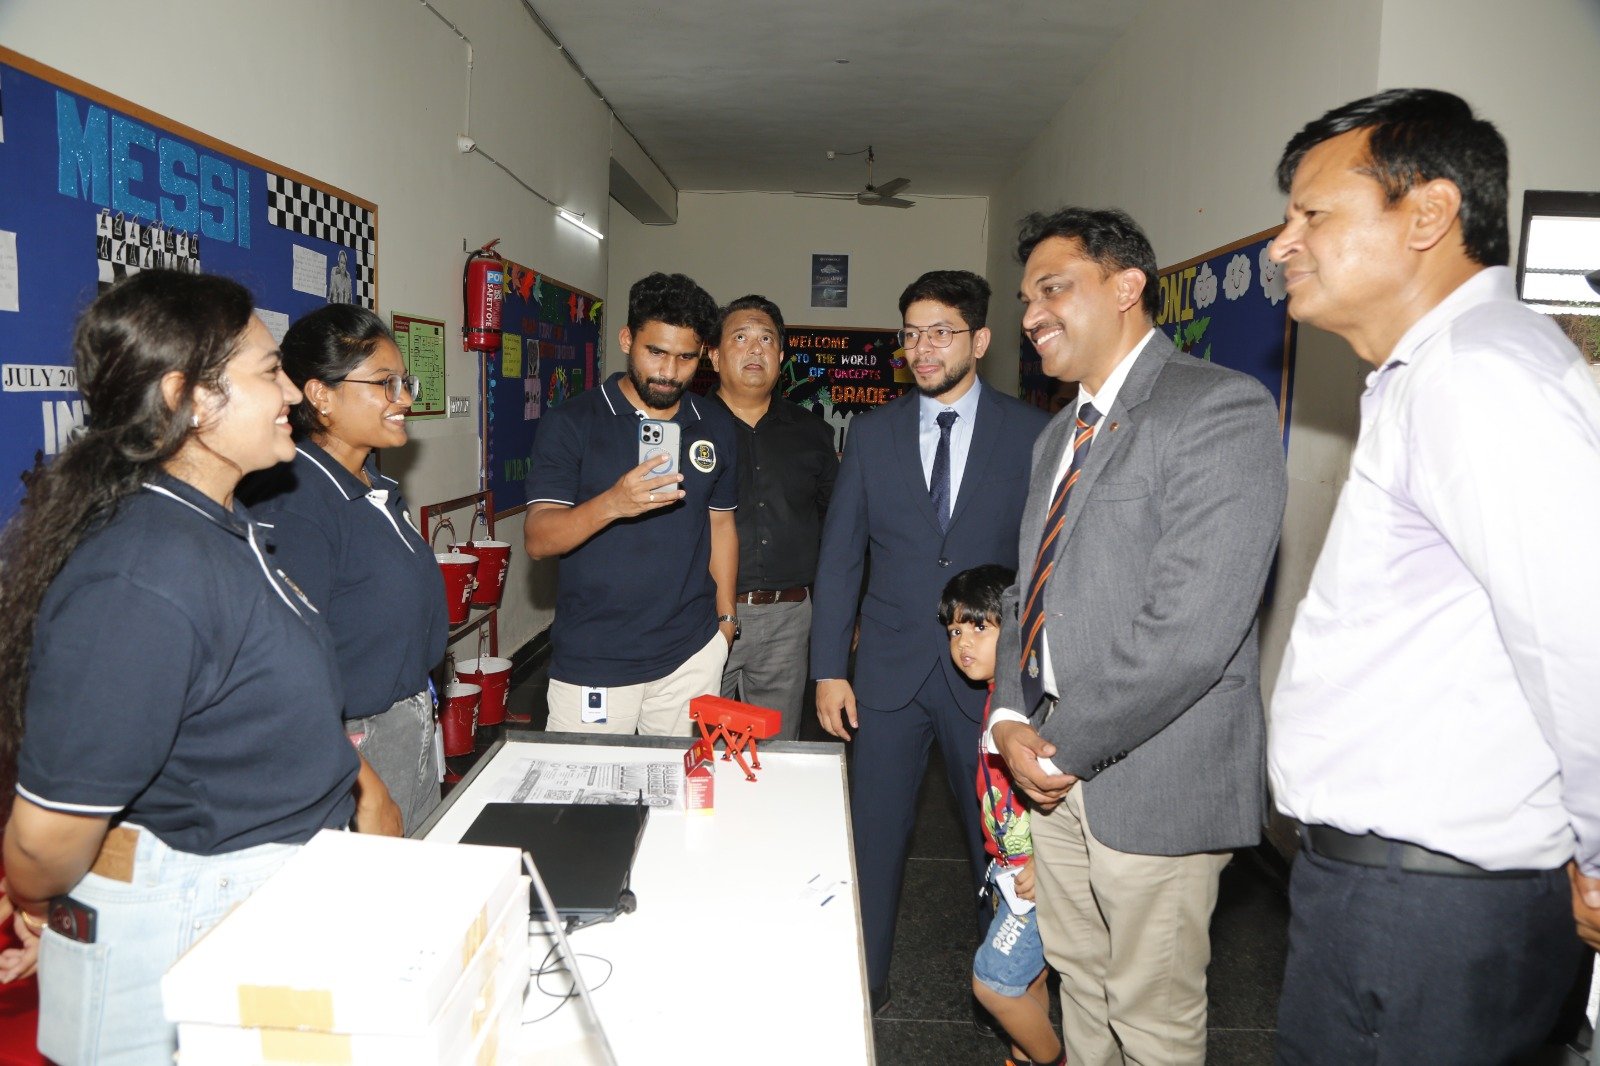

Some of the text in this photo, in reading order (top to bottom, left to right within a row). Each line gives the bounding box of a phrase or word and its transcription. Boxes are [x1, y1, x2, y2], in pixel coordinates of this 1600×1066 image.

[56, 90, 251, 249] MESSI
[789, 336, 849, 349] WELCOME
[795, 353, 877, 366] TO THE WORLD
[5, 367, 53, 387] JULY
[808, 366, 881, 381] OF CONCEPTS
[42, 400, 92, 455] IN
[994, 914, 1016, 949] KING
[999, 920, 1026, 956] LION
